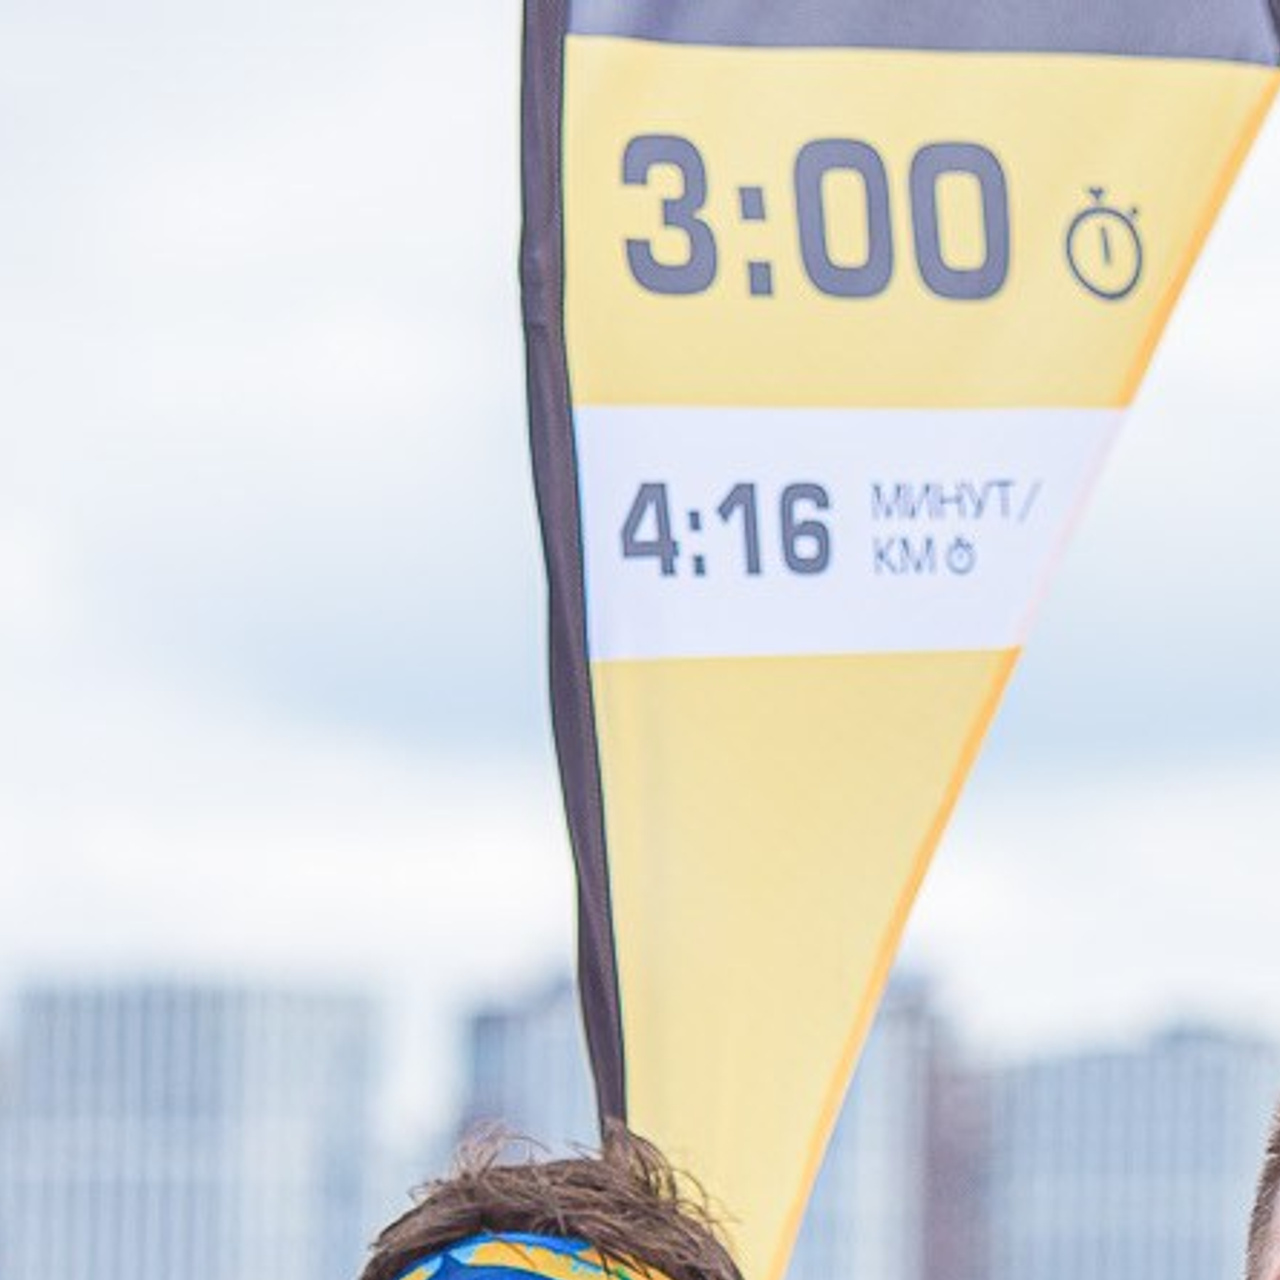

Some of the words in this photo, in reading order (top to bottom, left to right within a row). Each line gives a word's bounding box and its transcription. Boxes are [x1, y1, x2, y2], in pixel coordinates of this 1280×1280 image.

[620, 134, 1011, 301] 3:00
[620, 482, 832, 576] 4:16
[871, 536, 937, 576] КМ
